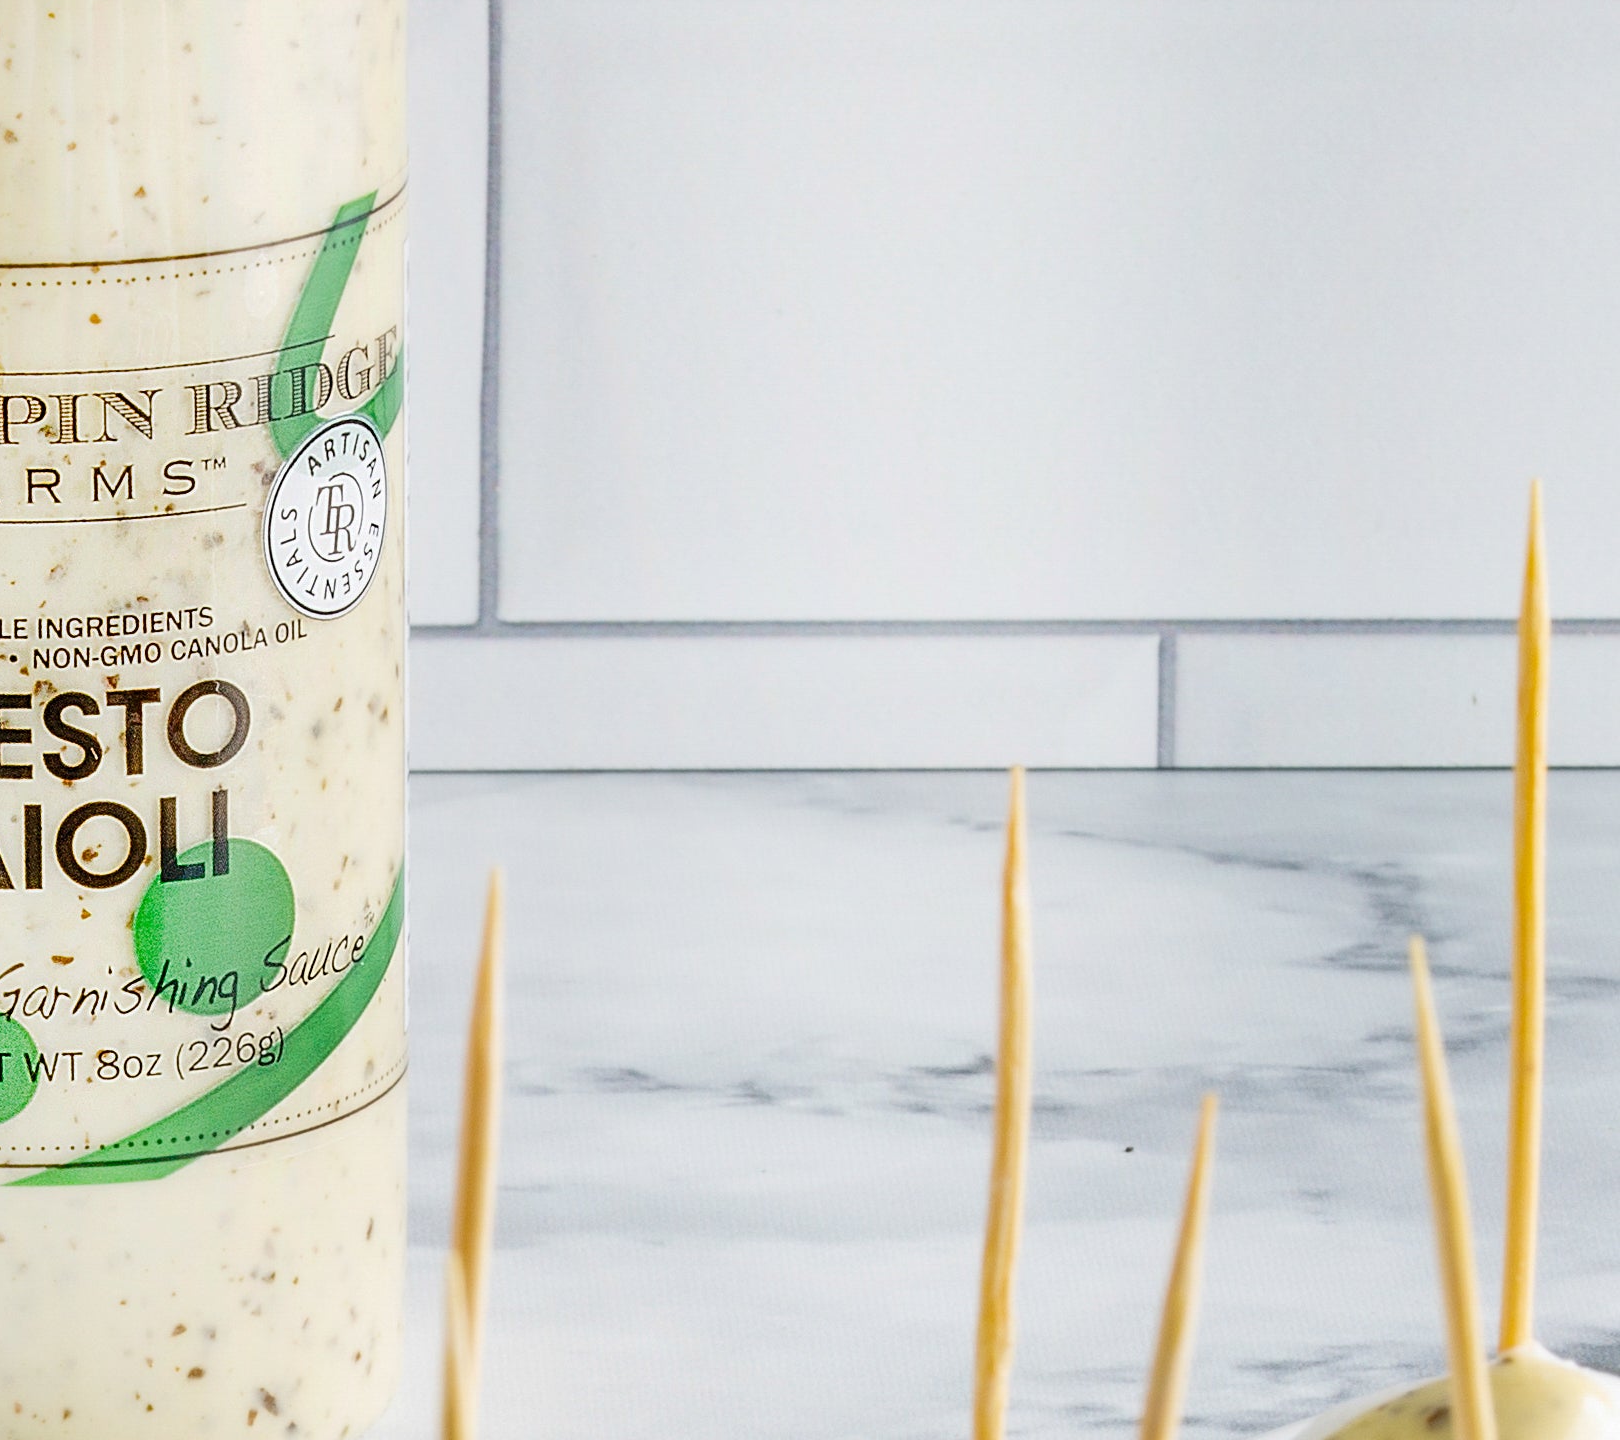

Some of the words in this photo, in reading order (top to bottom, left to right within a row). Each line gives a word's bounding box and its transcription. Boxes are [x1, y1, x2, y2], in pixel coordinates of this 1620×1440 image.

[185, 325, 398, 435] RIDGE
[307, 432, 382, 500] ARTISAN
[280, 508, 379, 600] ESSENTIALS
[33, 642, 161, 670] NON-GMO
[170, 628, 268, 661] CANOLA
[275, 618, 307, 644] OIL
[37, 606, 214, 640] INGREDIENTS
[23, 1051, 83, 1083] WT
[96, 1049, 162, 1081] 8oz
[175, 1026, 285, 1080] (226g)
